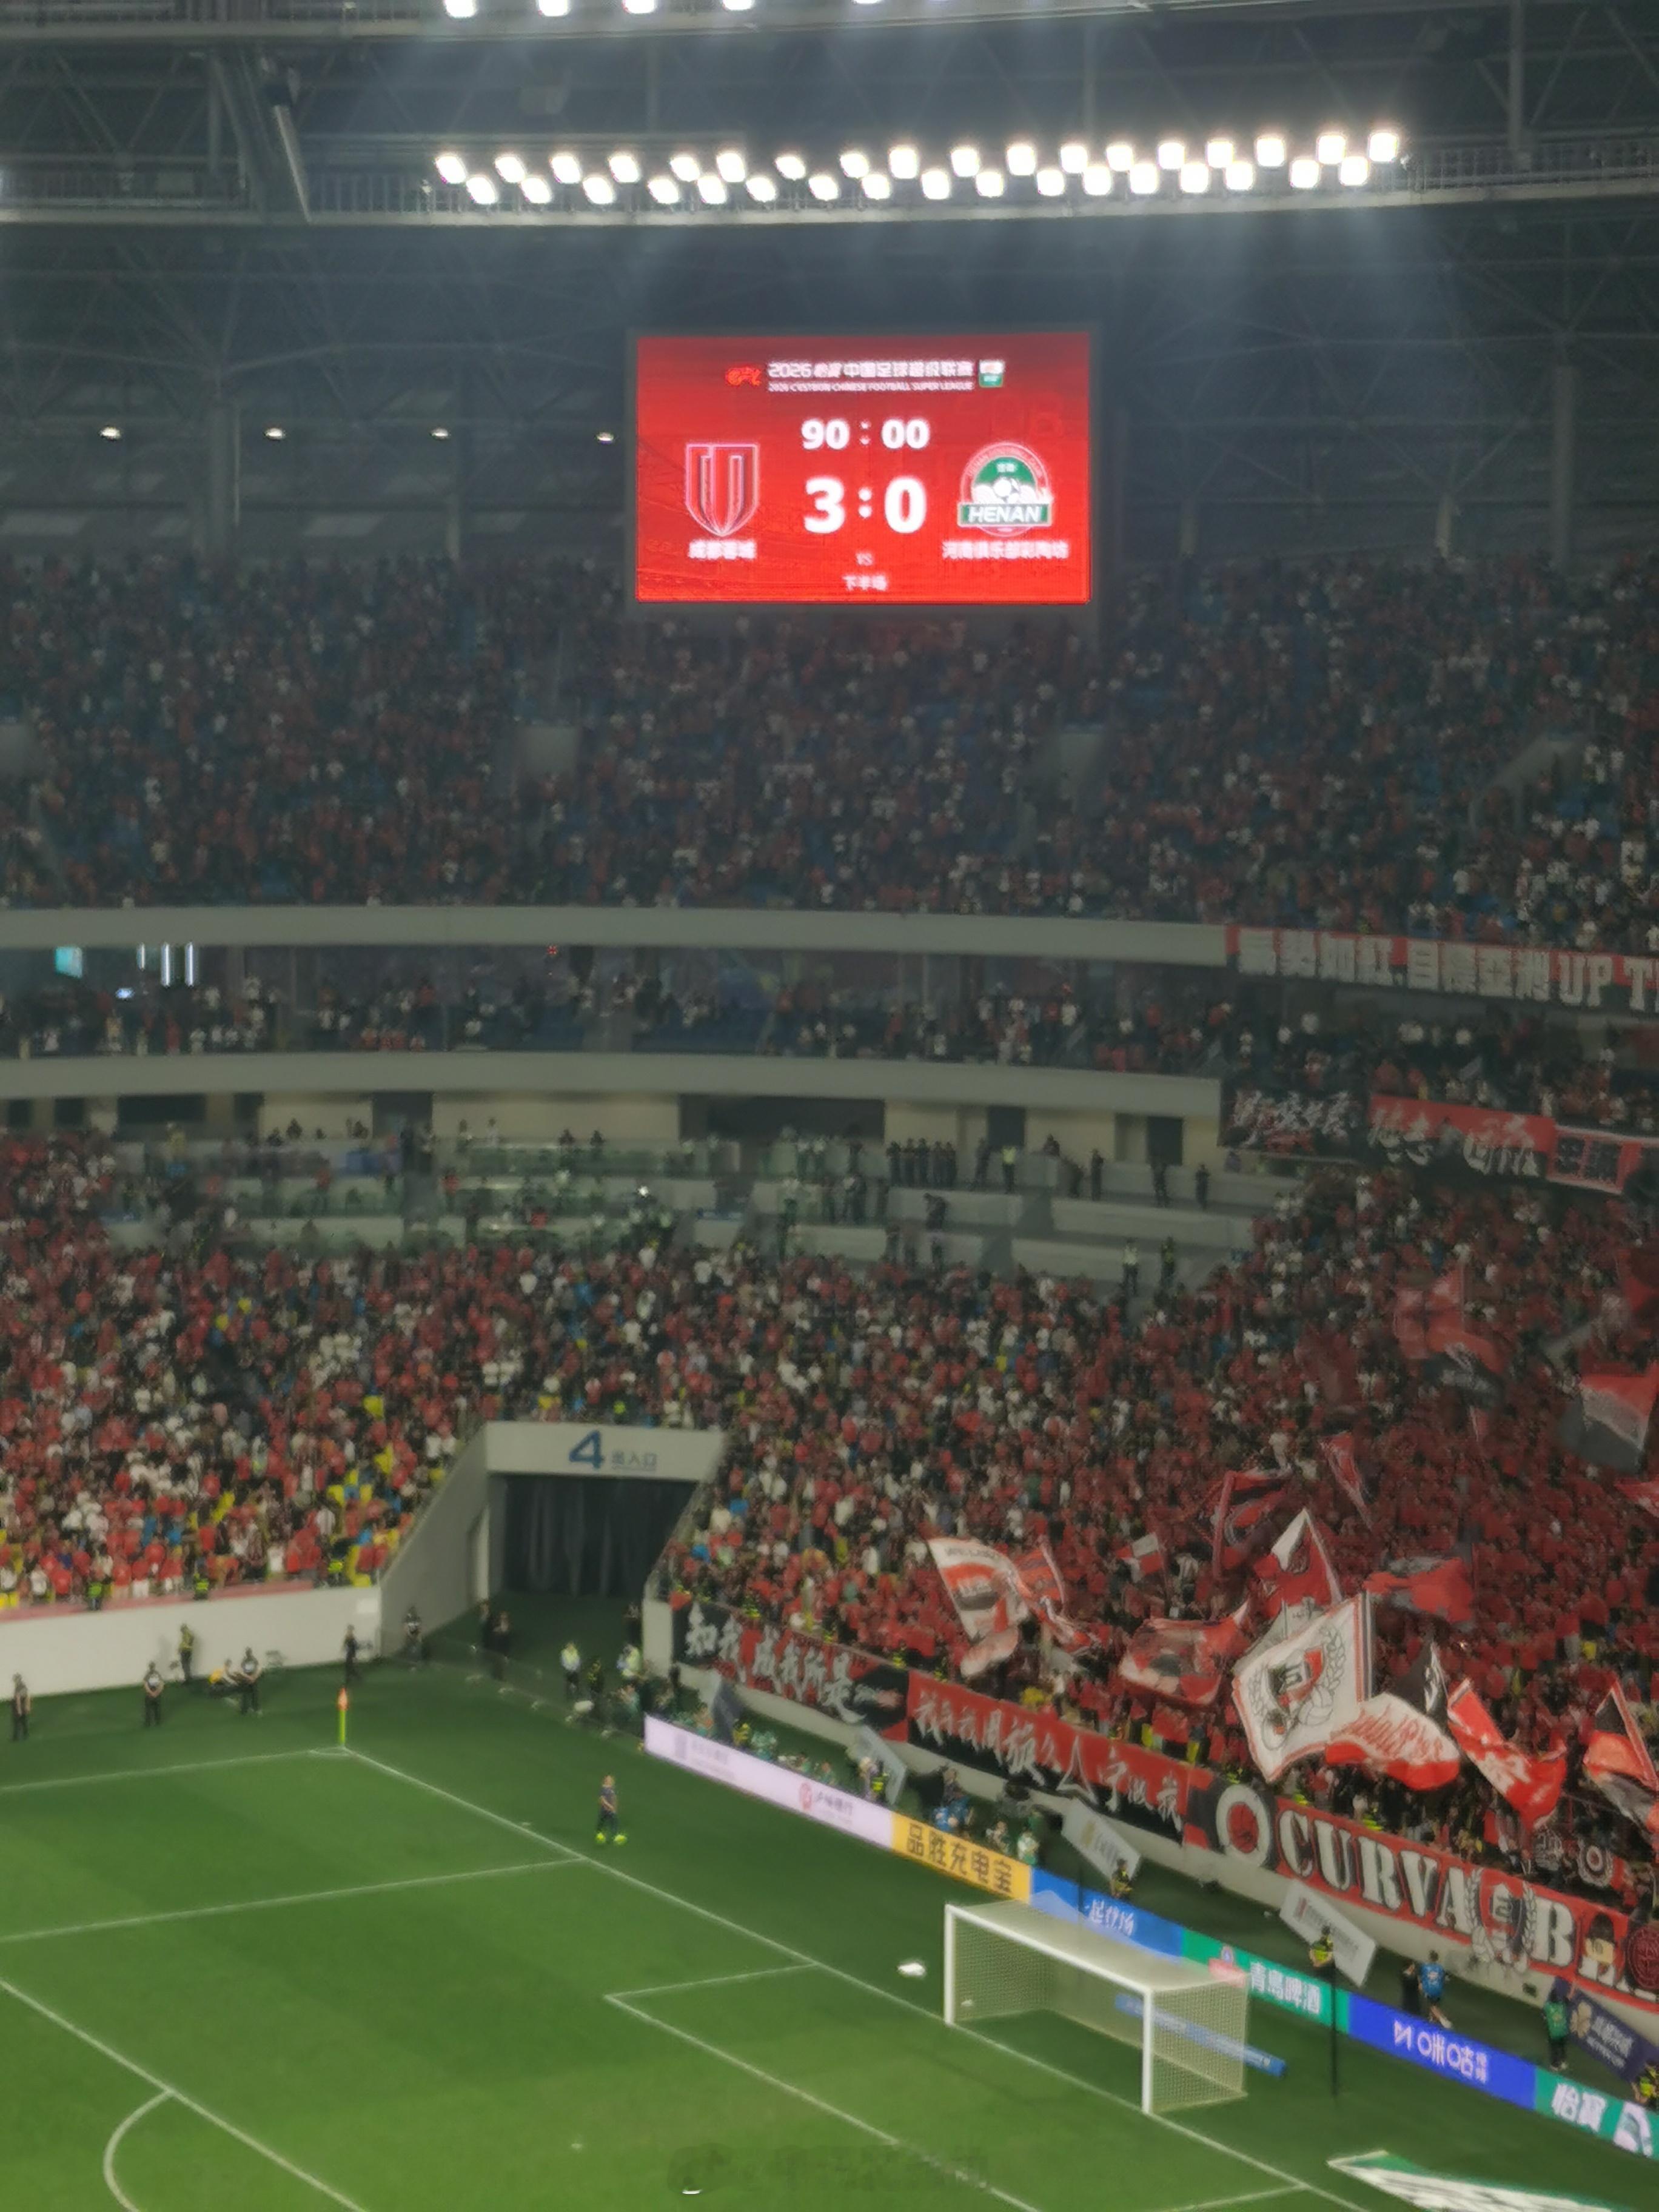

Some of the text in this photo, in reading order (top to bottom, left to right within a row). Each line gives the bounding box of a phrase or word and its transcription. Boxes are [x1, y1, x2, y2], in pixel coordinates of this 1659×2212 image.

[968, 506, 1041, 523] HENAN
[568, 1430, 605, 1470] 4
[906, 1823, 1013, 1894] 品胜充电宝
[1279, 1809, 1473, 1936] CURVA
[1529, 1894, 1574, 1967] B
[1250, 1961, 1321, 2015] 青岛啤酒
